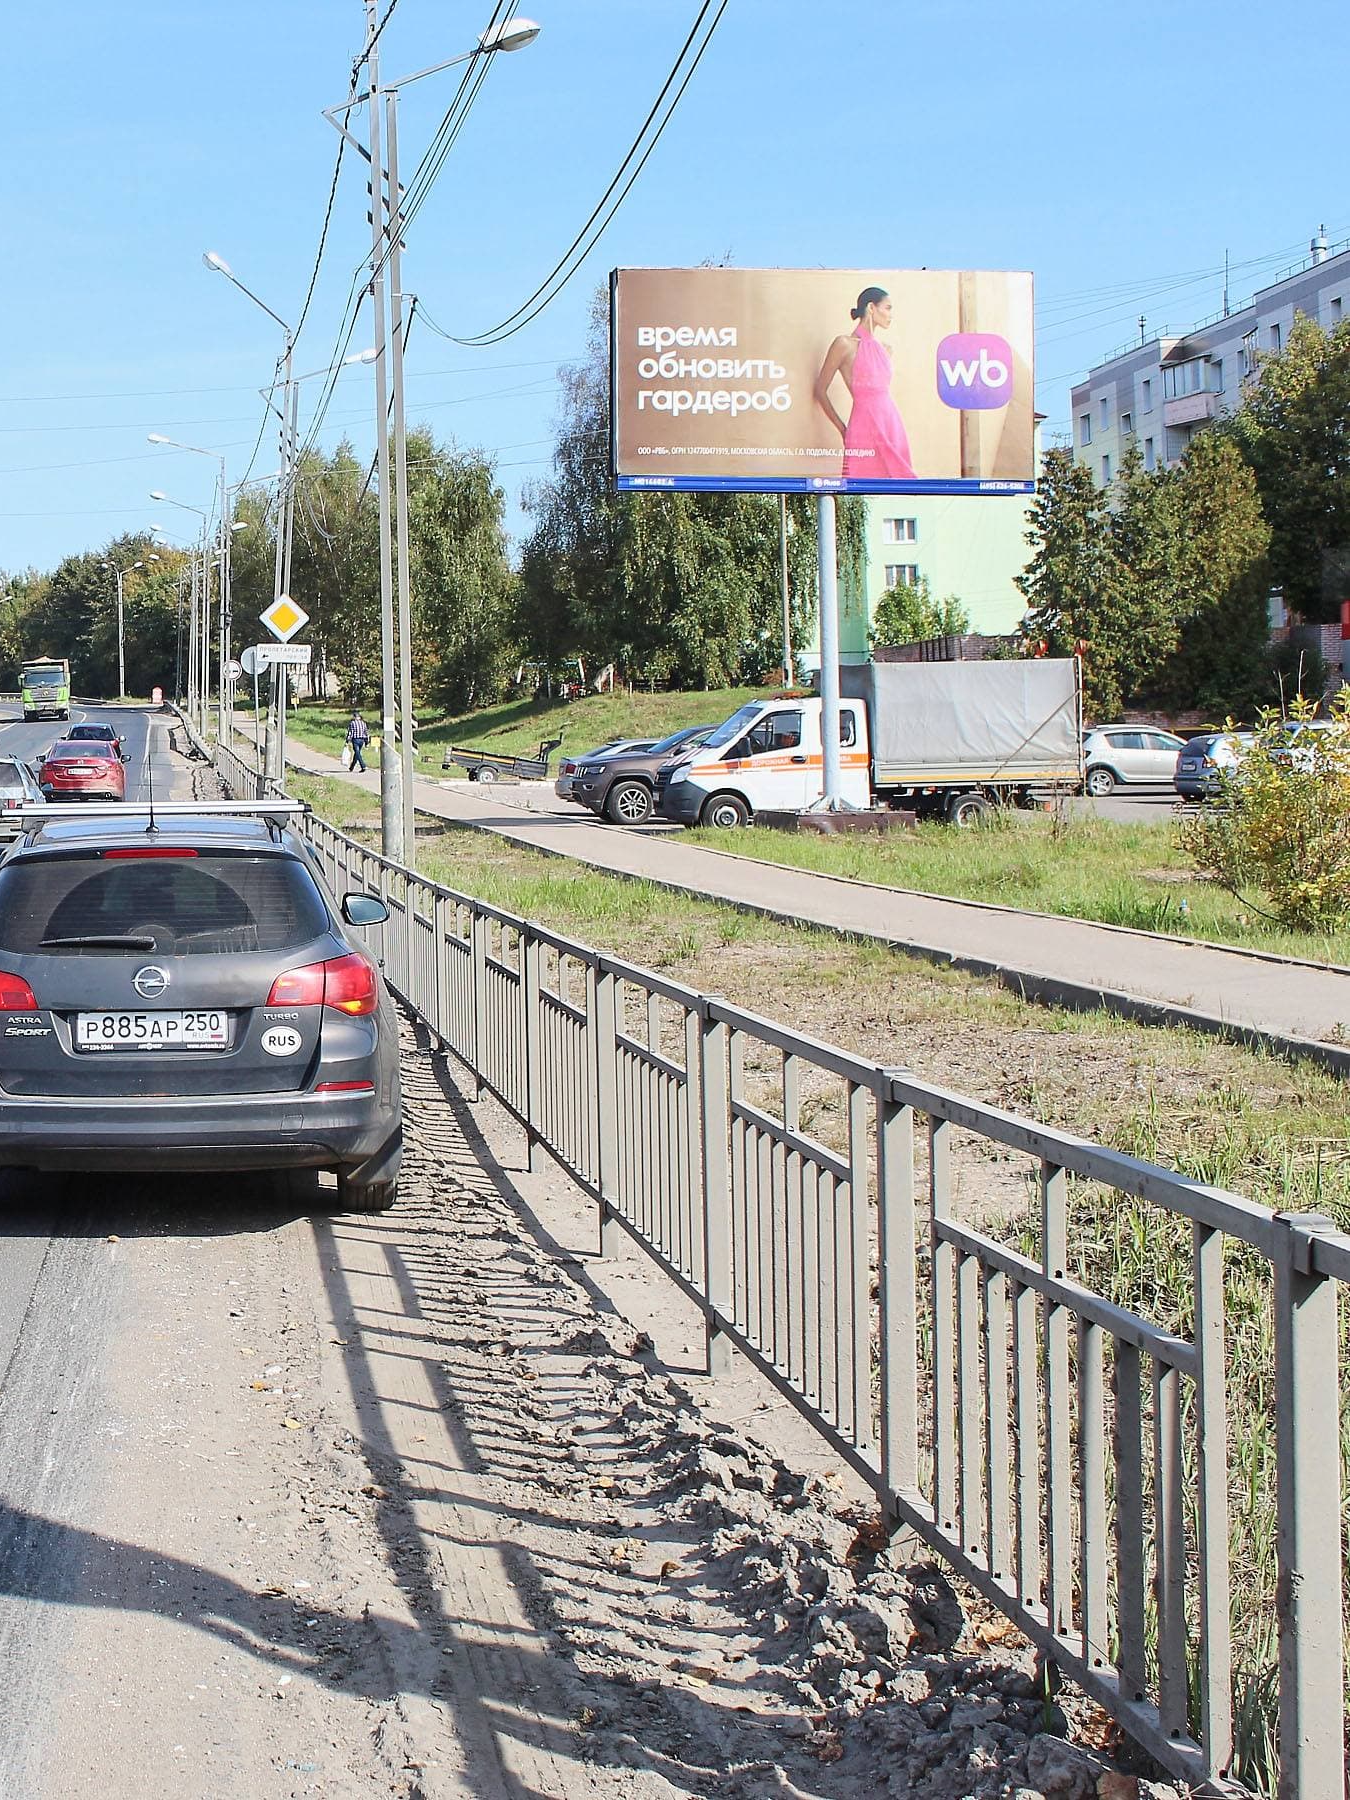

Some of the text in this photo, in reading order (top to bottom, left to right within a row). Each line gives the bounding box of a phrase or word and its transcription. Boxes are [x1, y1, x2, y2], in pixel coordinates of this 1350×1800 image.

[638, 326, 738, 353] время
[638, 350, 787, 379] обновить
[940, 348, 1008, 388] wb
[638, 384, 793, 417] гардероб
[7, 1016, 42, 1024] ASTRA
[268, 1035, 296, 1047] RUS
